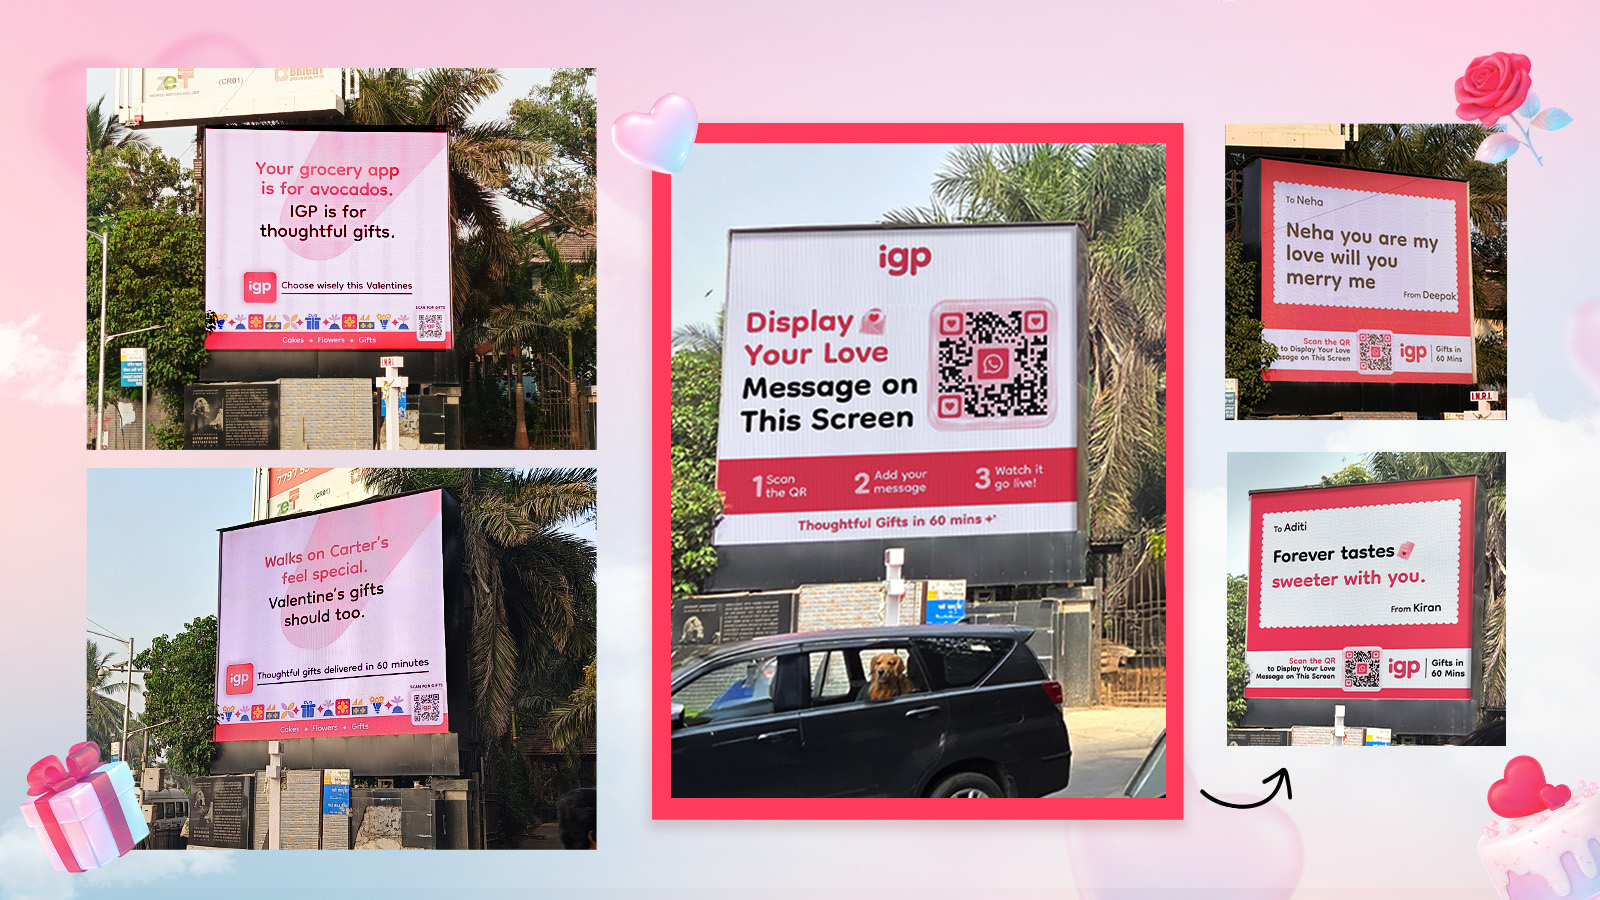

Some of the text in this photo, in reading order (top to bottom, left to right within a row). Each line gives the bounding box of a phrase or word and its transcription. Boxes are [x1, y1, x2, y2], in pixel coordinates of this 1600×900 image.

[218, 77, 244, 87] (CR01)
[255, 161, 400, 181] Your grocery app
[261, 180, 393, 197] is for avocados.
[1285, 195, 1324, 207] To Neha
[290, 204, 367, 219] IGP is for
[260, 224, 394, 241] thoughtful gifts.
[1287, 222, 1438, 253] Neha you are my
[880, 245, 931, 276] igp
[1287, 244, 1397, 271] love will you
[248, 280, 272, 295] igp
[281, 281, 413, 292] Choose wisely this Valentines
[1287, 273, 1376, 291] merry me
[1403, 290, 1457, 303] From Deepak
[747, 309, 853, 338] Display
[282, 336, 377, 344] Cakes Flowers Gifts
[1303, 337, 1351, 347] Scan the QR
[745, 343, 888, 366] Your Love
[1289, 345, 1316, 354] Display
[1317, 346, 1334, 354] Your
[1335, 346, 1351, 354] Love
[1400, 343, 1427, 363] igp
[1435, 345, 1453, 353] Gifts
[1311, 354, 1326, 362] This
[1327, 354, 1351, 362] Screen
[1435, 354, 1463, 363] 60 Mins
[743, 377, 917, 403] Message on
[741, 408, 913, 432] This Screen
[277, 468, 297, 486] 7797
[873, 469, 928, 483] Add your
[999, 463, 1044, 476] Watch it
[766, 474, 796, 485] Scan
[855, 473, 870, 494] 2
[975, 468, 991, 489] 3
[994, 477, 1037, 492] go live!
[313, 487, 331, 501] (CR01)
[753, 476, 762, 497] 1
[765, 486, 807, 499] the QR
[873, 484, 927, 496] message
[798, 513, 983, 533] Thoughtful Gifts in 60 mins
[1273, 521, 1307, 533] To Aditi
[265, 552, 302, 568] Walks
[307, 550, 325, 562] on
[1273, 544, 1395, 564] Forever tastes
[282, 561, 368, 584] feel special.
[1272, 570, 1425, 588] sweeter with you.
[350, 583, 383, 602] gifts
[1390, 602, 1442, 613] From Kiran
[285, 608, 365, 626] should too.
[1289, 656, 1336, 665] Scan the QR
[1431, 658, 1464, 667] Gifts in
[257, 658, 430, 681] Thoughtful gifts delivered in 60 minutes
[1276, 665, 1301, 673] Display
[1389, 658, 1420, 679] igp
[1431, 669, 1466, 678] 60 Mins
[229, 673, 250, 688] igp
[1255, 673, 1284, 682] Message
[1296, 672, 1310, 680] This
[1311, 672, 1336, 680] Screen
[279, 721, 370, 734] Cakes Flowers Gifts
